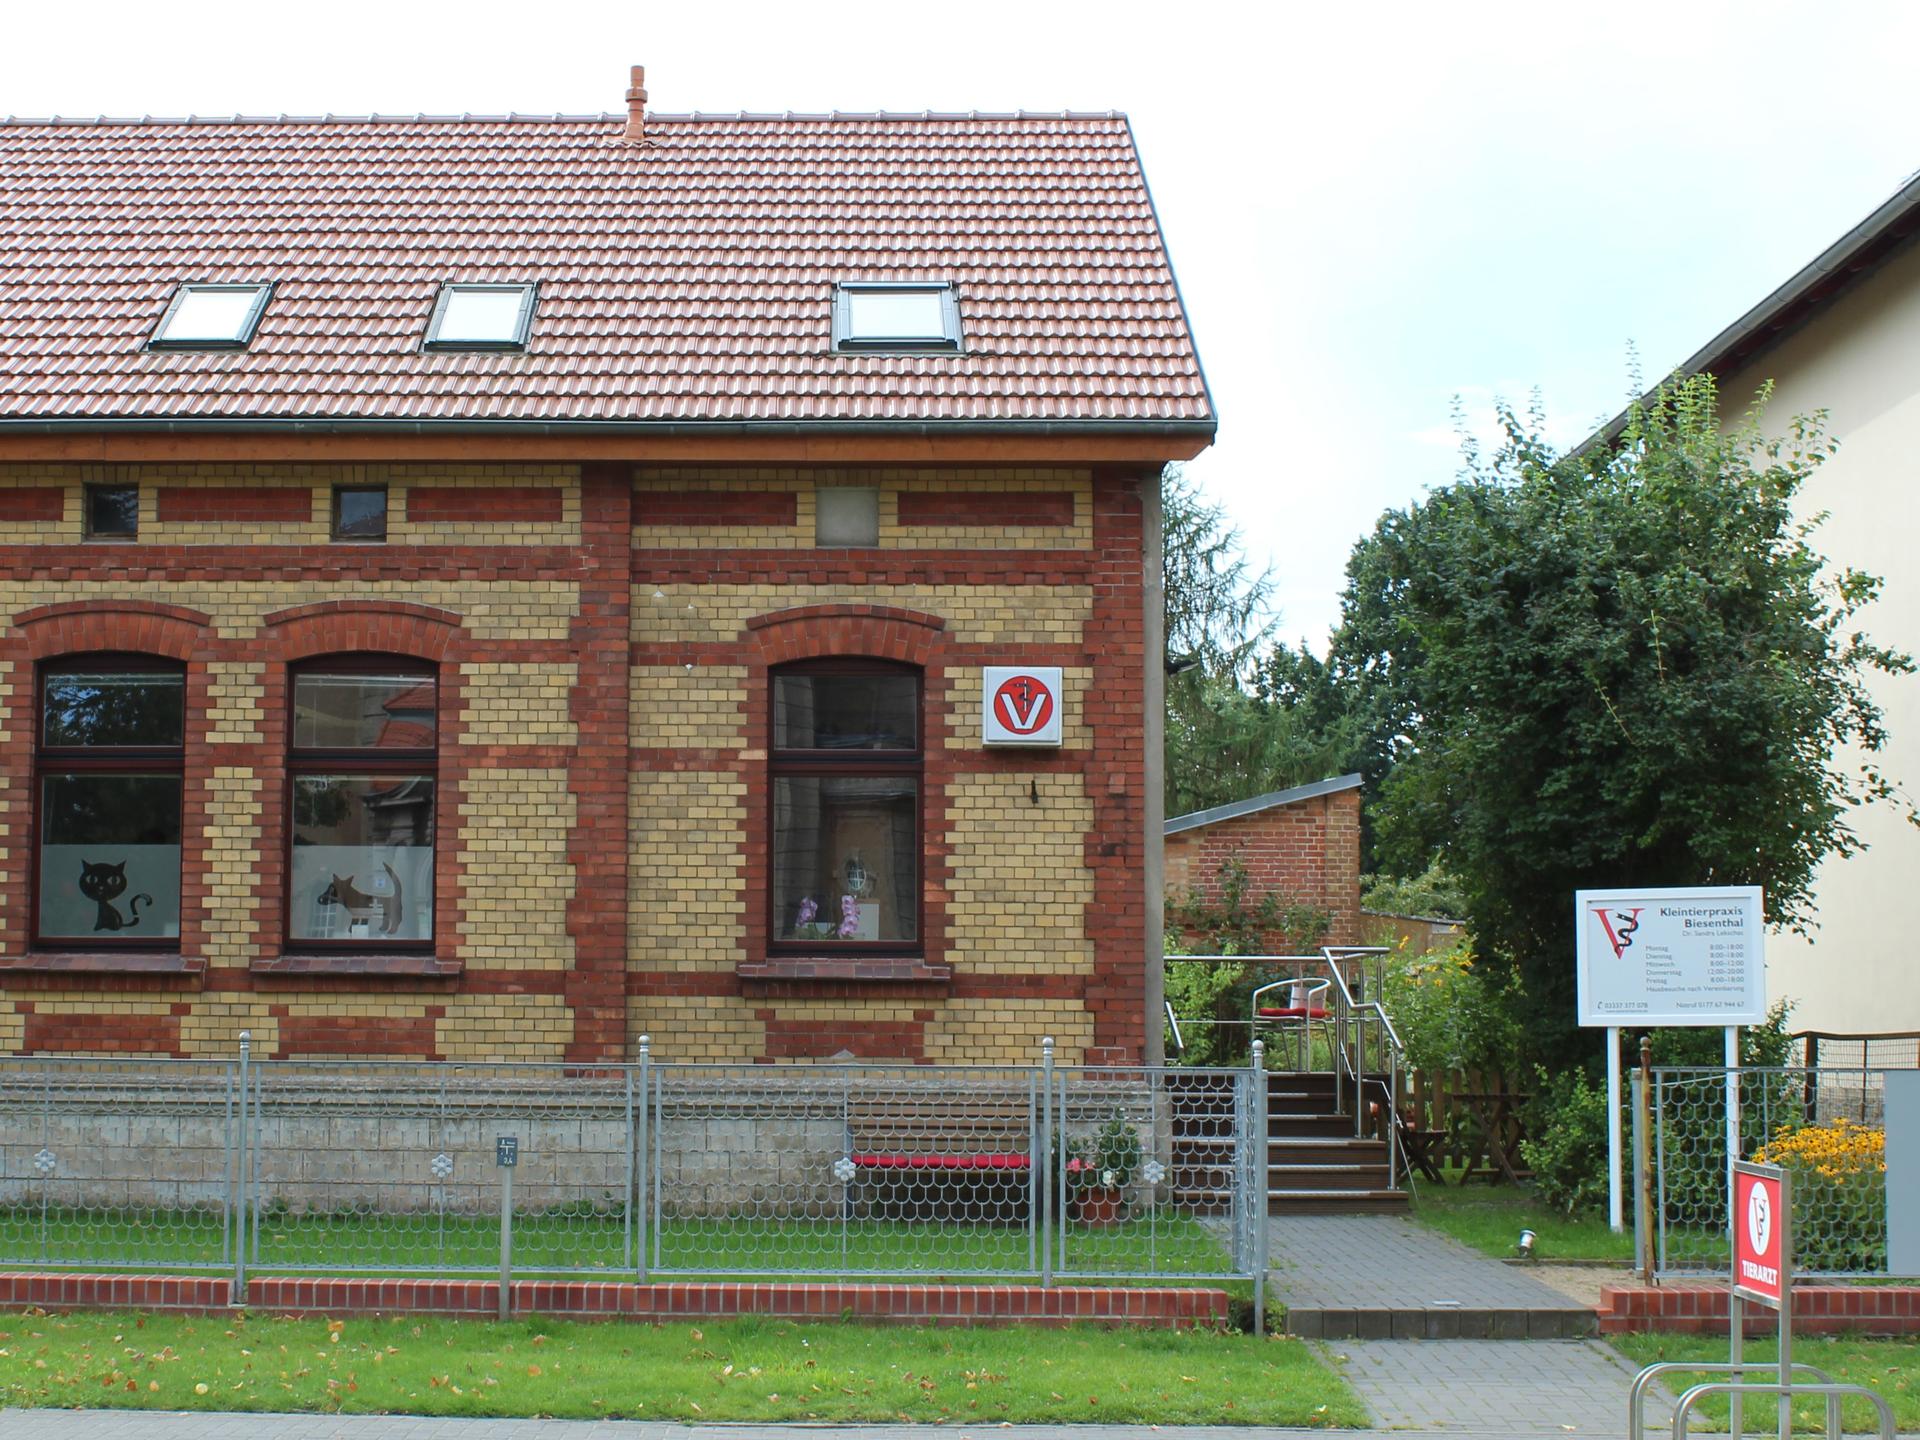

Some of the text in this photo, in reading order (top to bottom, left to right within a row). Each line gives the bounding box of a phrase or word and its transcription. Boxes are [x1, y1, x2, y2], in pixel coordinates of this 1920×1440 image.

[1660, 907, 1743, 918] Kleintierpraxis
[1684, 918, 1744, 928] Biesenthal
[1645, 945, 1669, 953] Montag
[1645, 953, 1672, 961] Dienstag
[1646, 969, 1682, 977] Donnerstag
[1646, 977, 1668, 985] Freitag
[1742, 1259, 1778, 1286] TIERARZT
